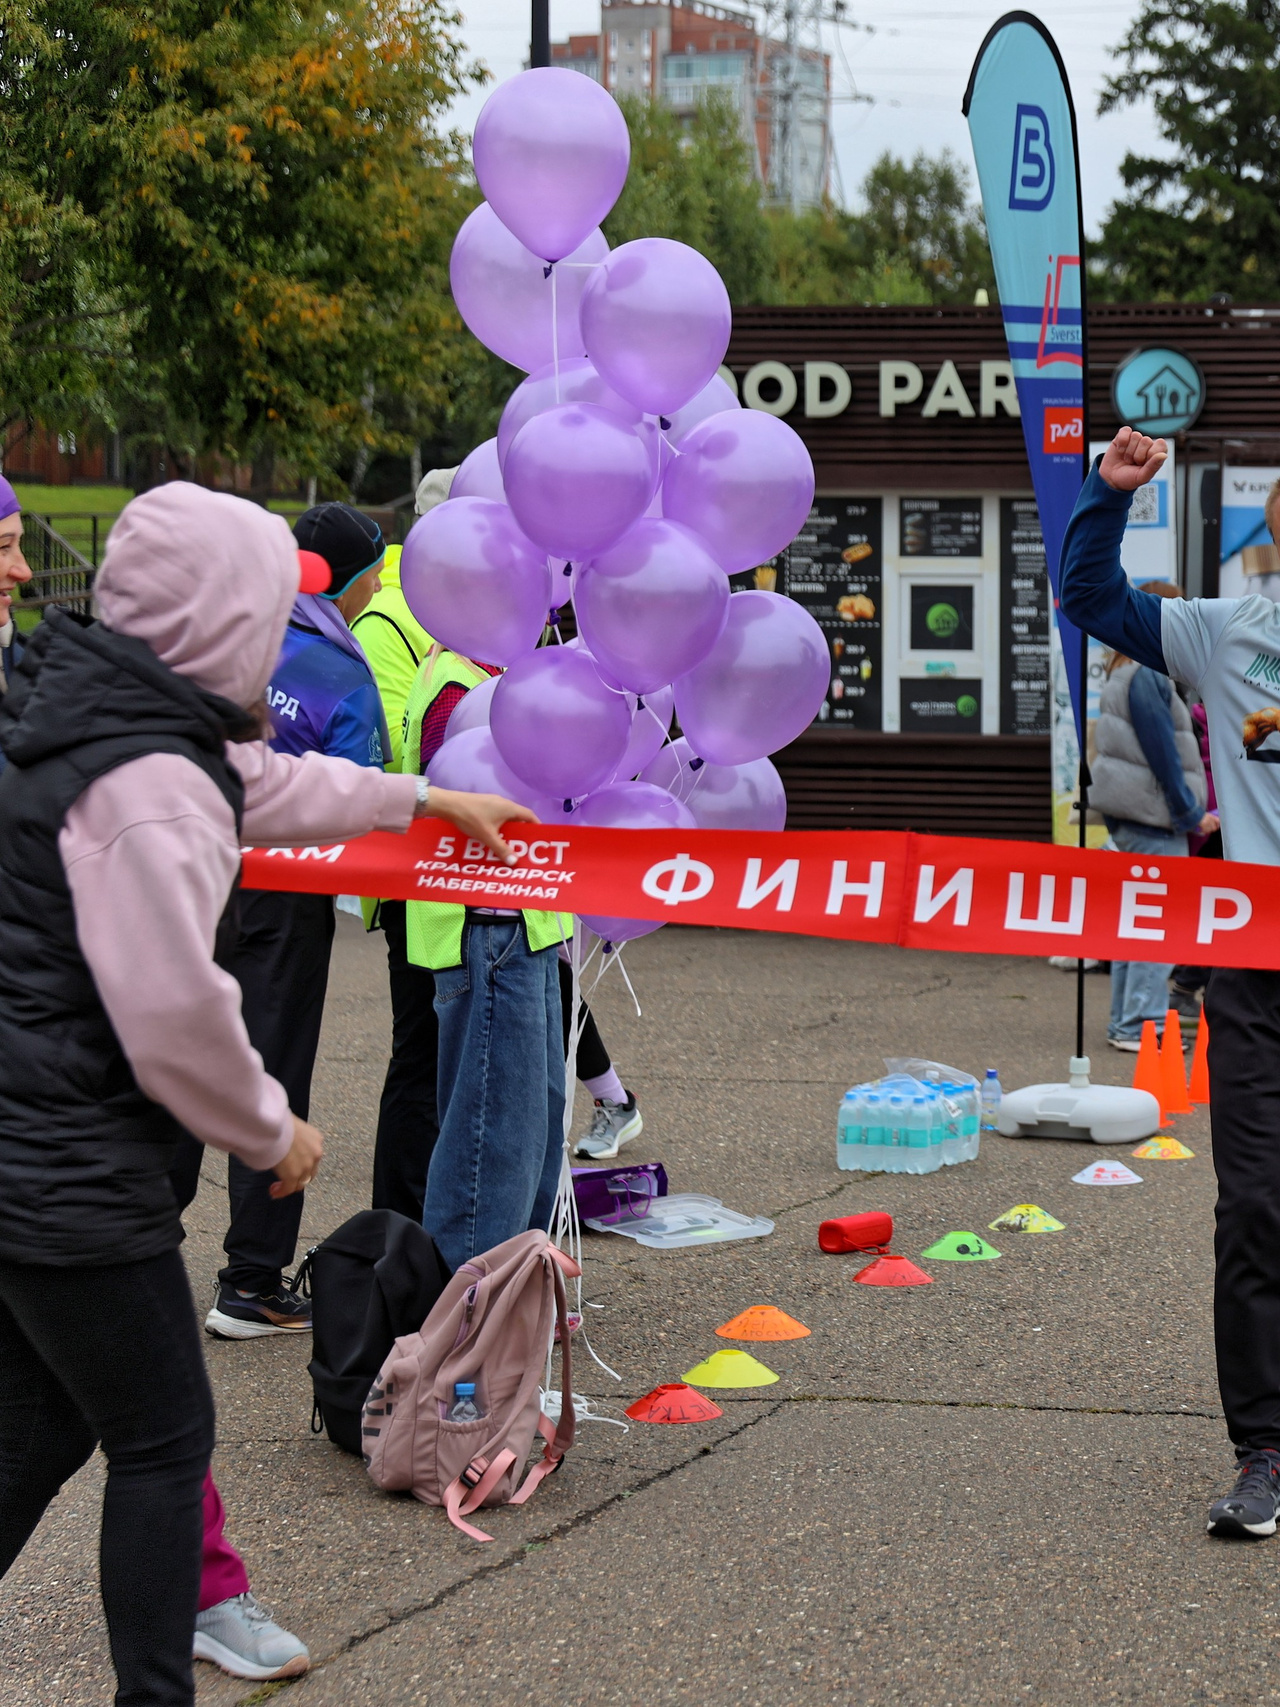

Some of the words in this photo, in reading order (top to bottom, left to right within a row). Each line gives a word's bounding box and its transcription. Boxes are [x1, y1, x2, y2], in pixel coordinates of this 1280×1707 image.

[719, 360, 852, 418] OD
[879, 359, 1021, 418] PAR
[264, 684, 301, 722] АРД
[434, 836, 456, 858] 5
[414, 859, 577, 884] КРАСНОЯРСК
[416, 874, 560, 900] НАБЕРЕЖНАЯ
[640, 852, 1254, 945] ФИНИШЁР
